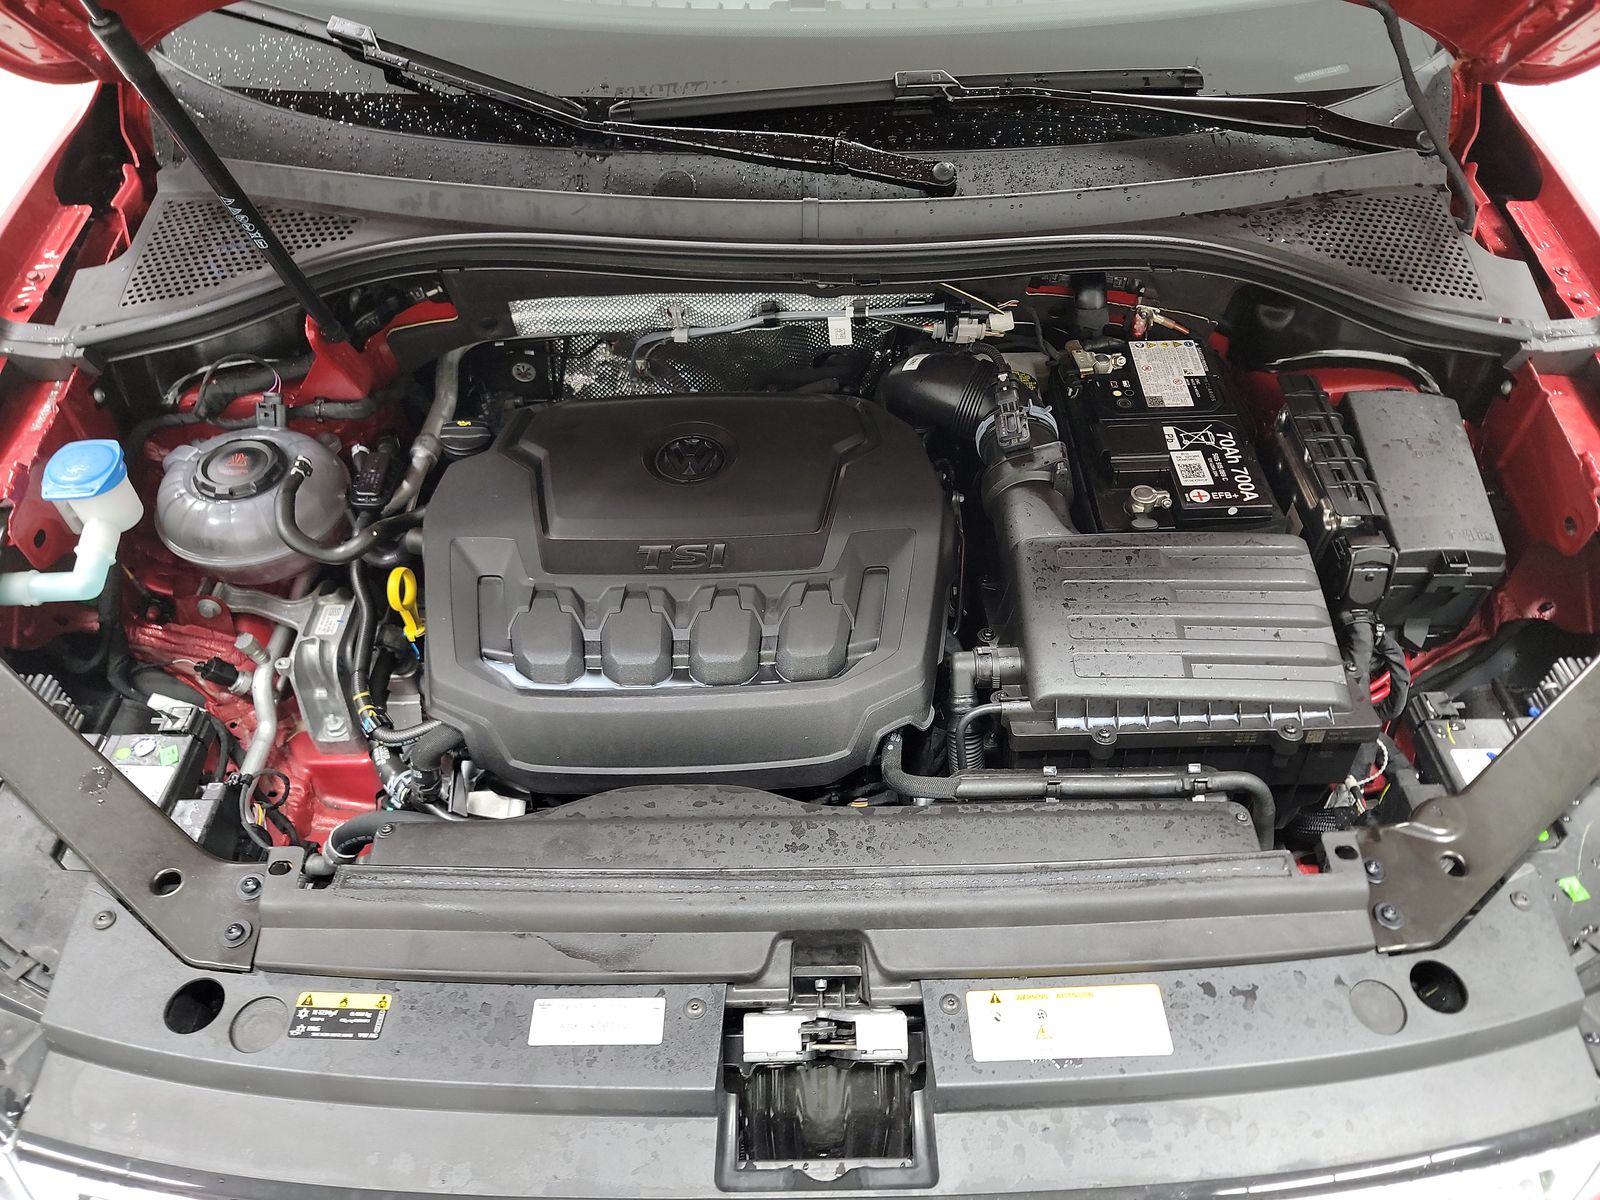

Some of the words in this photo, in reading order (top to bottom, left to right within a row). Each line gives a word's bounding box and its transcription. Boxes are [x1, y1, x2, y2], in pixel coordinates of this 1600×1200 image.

[1164, 433, 1174, 443] Pb
[1216, 431, 1243, 464] 70Ah
[1230, 466, 1260, 502] 700A
[636, 543, 727, 570] TSI
